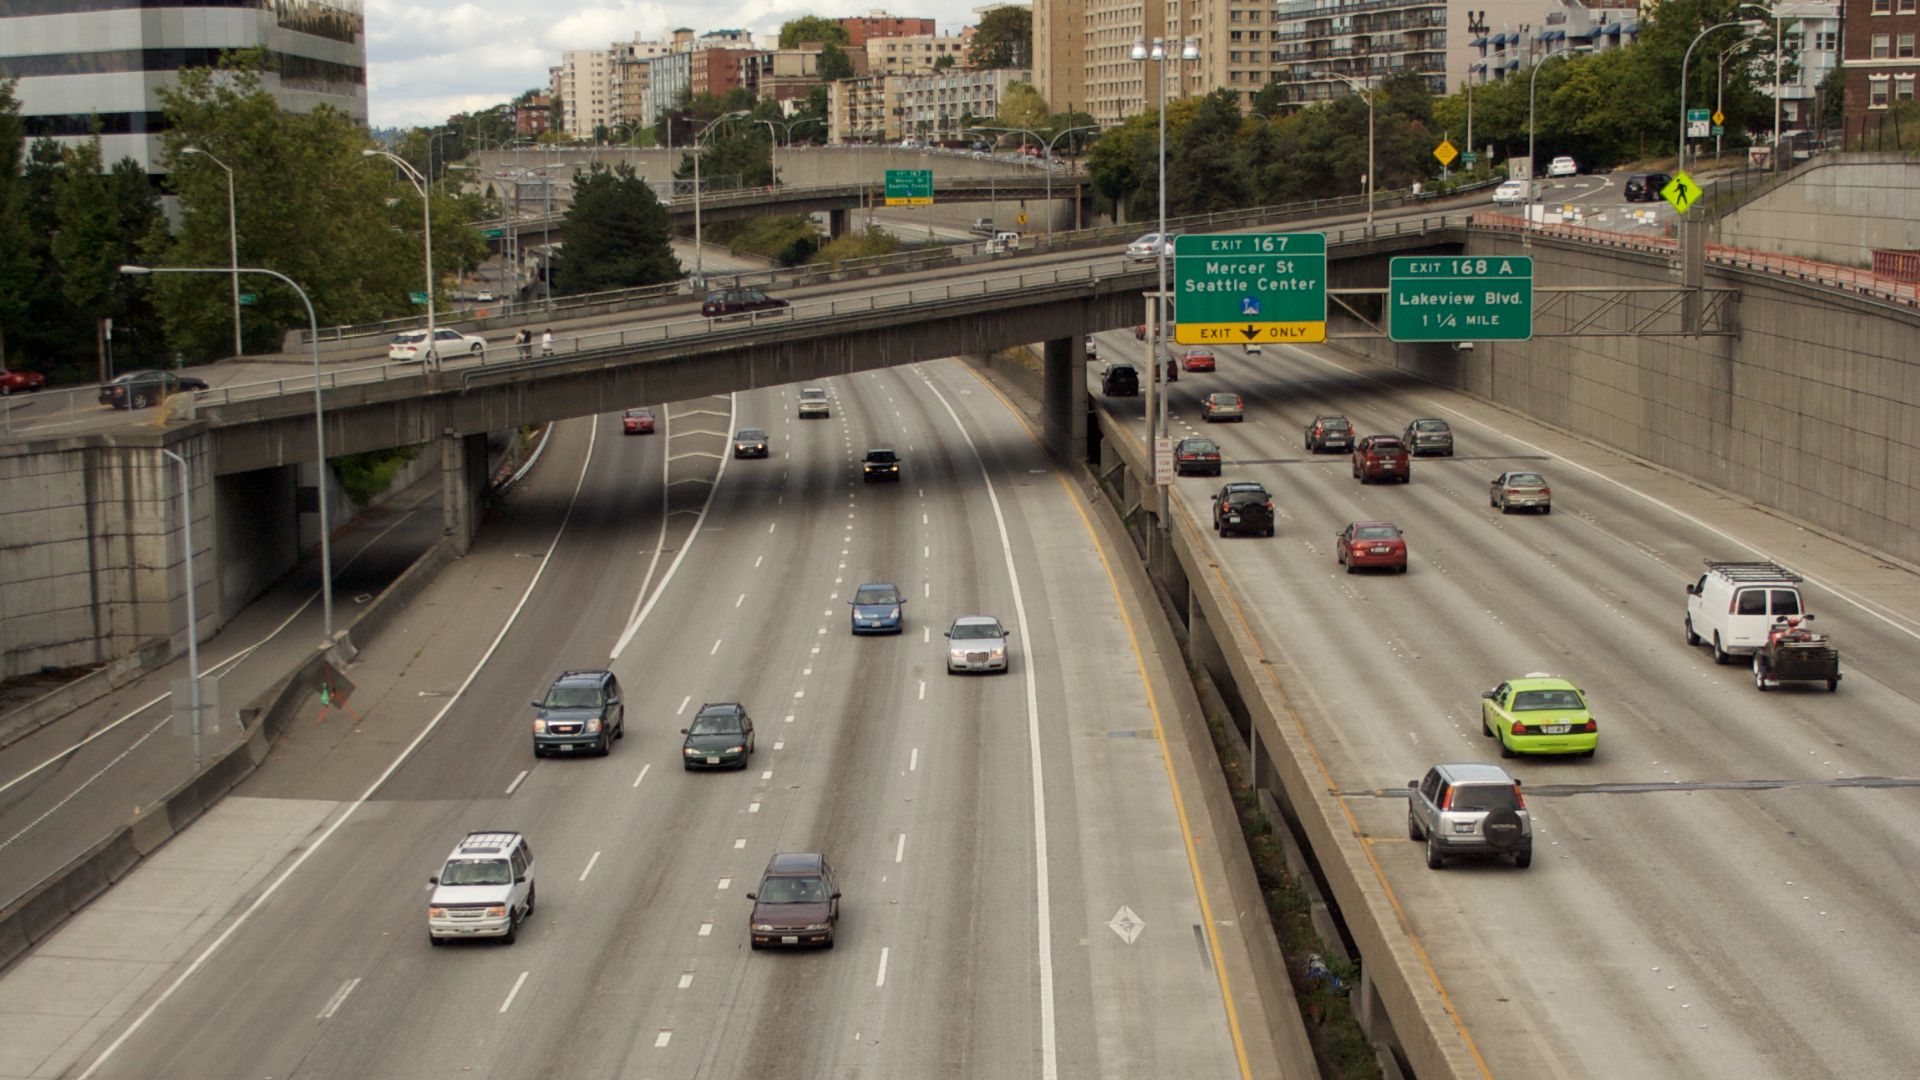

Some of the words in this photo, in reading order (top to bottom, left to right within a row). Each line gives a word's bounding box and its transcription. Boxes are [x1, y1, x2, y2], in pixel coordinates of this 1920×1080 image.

[1211, 240, 1243, 250] EXIT
[1254, 237, 1288, 252] 167
[1206, 262, 1265, 274] Mercer
[1276, 260, 1294, 273] St
[1410, 263, 1441, 273] EXIT
[1452, 260, 1487, 275] 168
[1499, 260, 1513, 275] A
[1185, 279, 1248, 292] Seattle
[1257, 277, 1315, 291] Center
[1400, 291, 1475, 305] Lakeview
[1485, 292, 1522, 305] Blvd.
[1466, 315, 1499, 325] MILE
[1200, 328, 1231, 338] EXIT
[1270, 327, 1306, 337] ONLY
